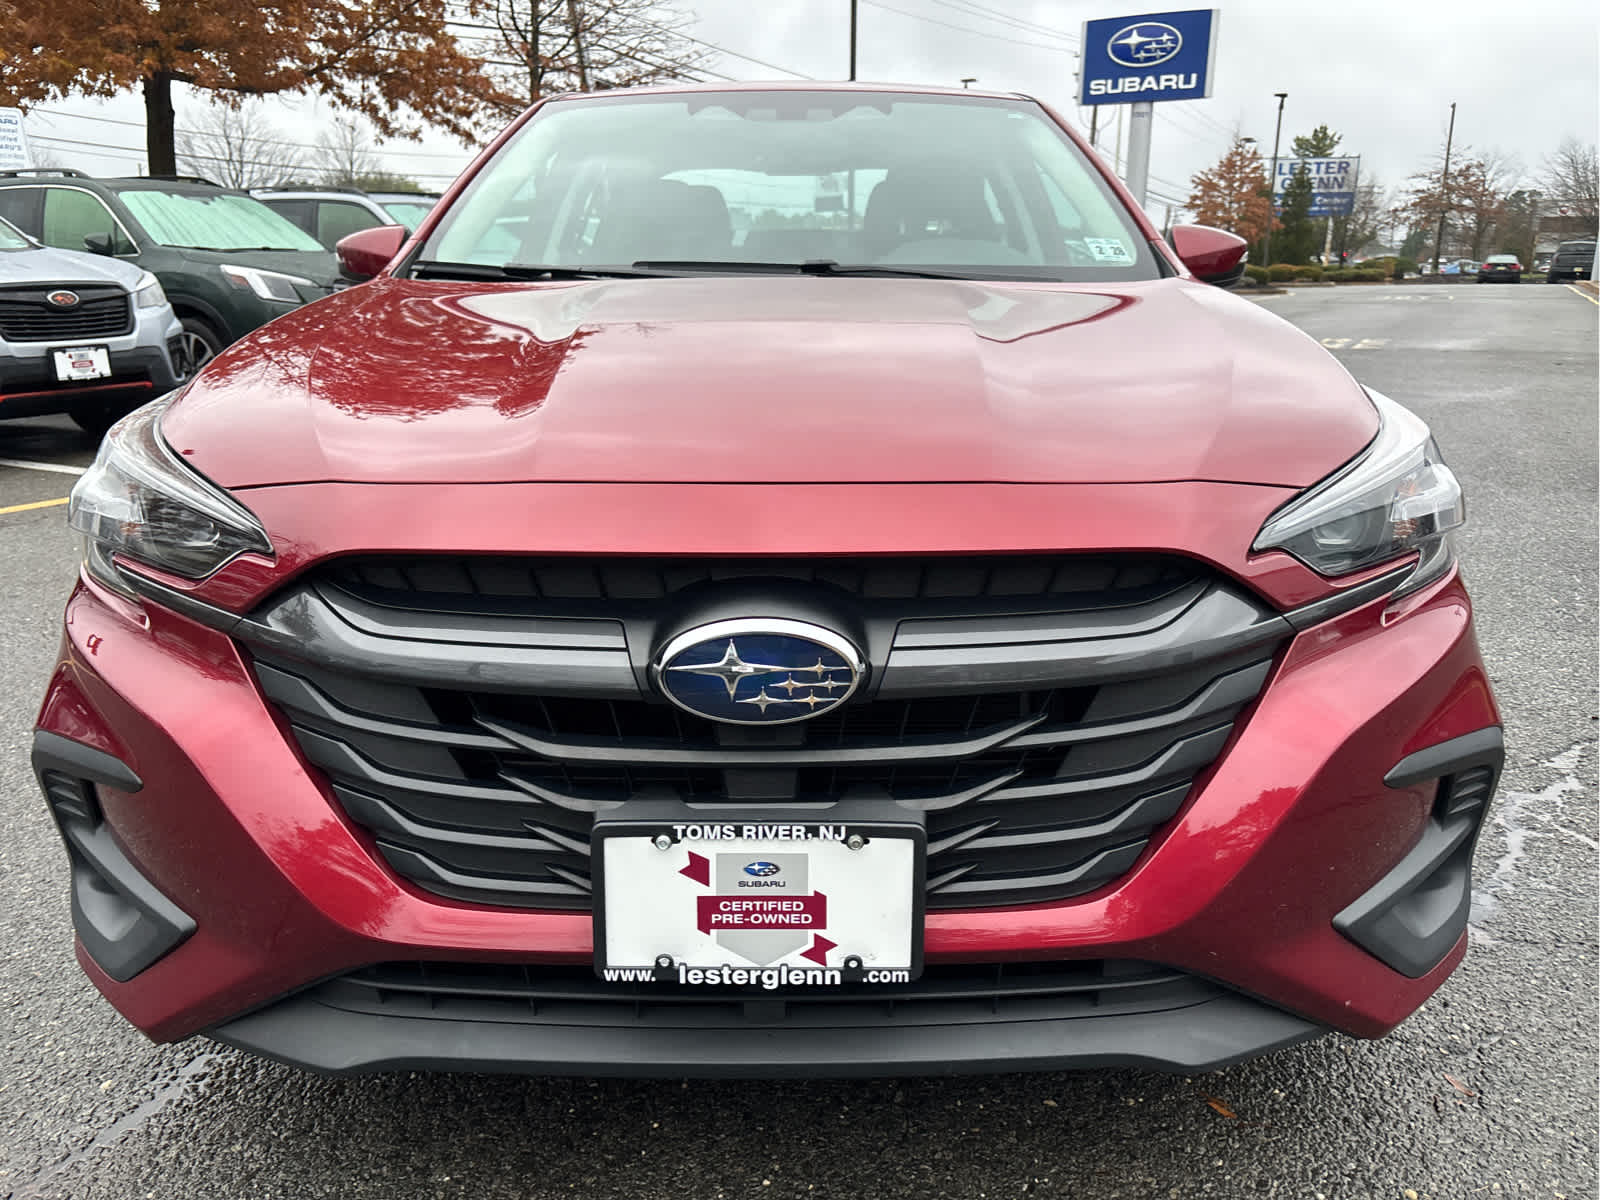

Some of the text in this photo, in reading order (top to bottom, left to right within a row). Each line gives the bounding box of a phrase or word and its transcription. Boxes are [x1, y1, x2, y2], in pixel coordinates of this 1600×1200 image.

[1089, 73, 1197, 95] SUBARU
[1279, 161, 1350, 176] LESTER
[673, 825, 847, 841] TOMS RIVER, NJ
[738, 880, 786, 888] SUBARU
[719, 901, 804, 912] CERTIFIED
[711, 914, 812, 925] PRE-OWNED
[604, 966, 909, 989] www. lesterglenn .com
